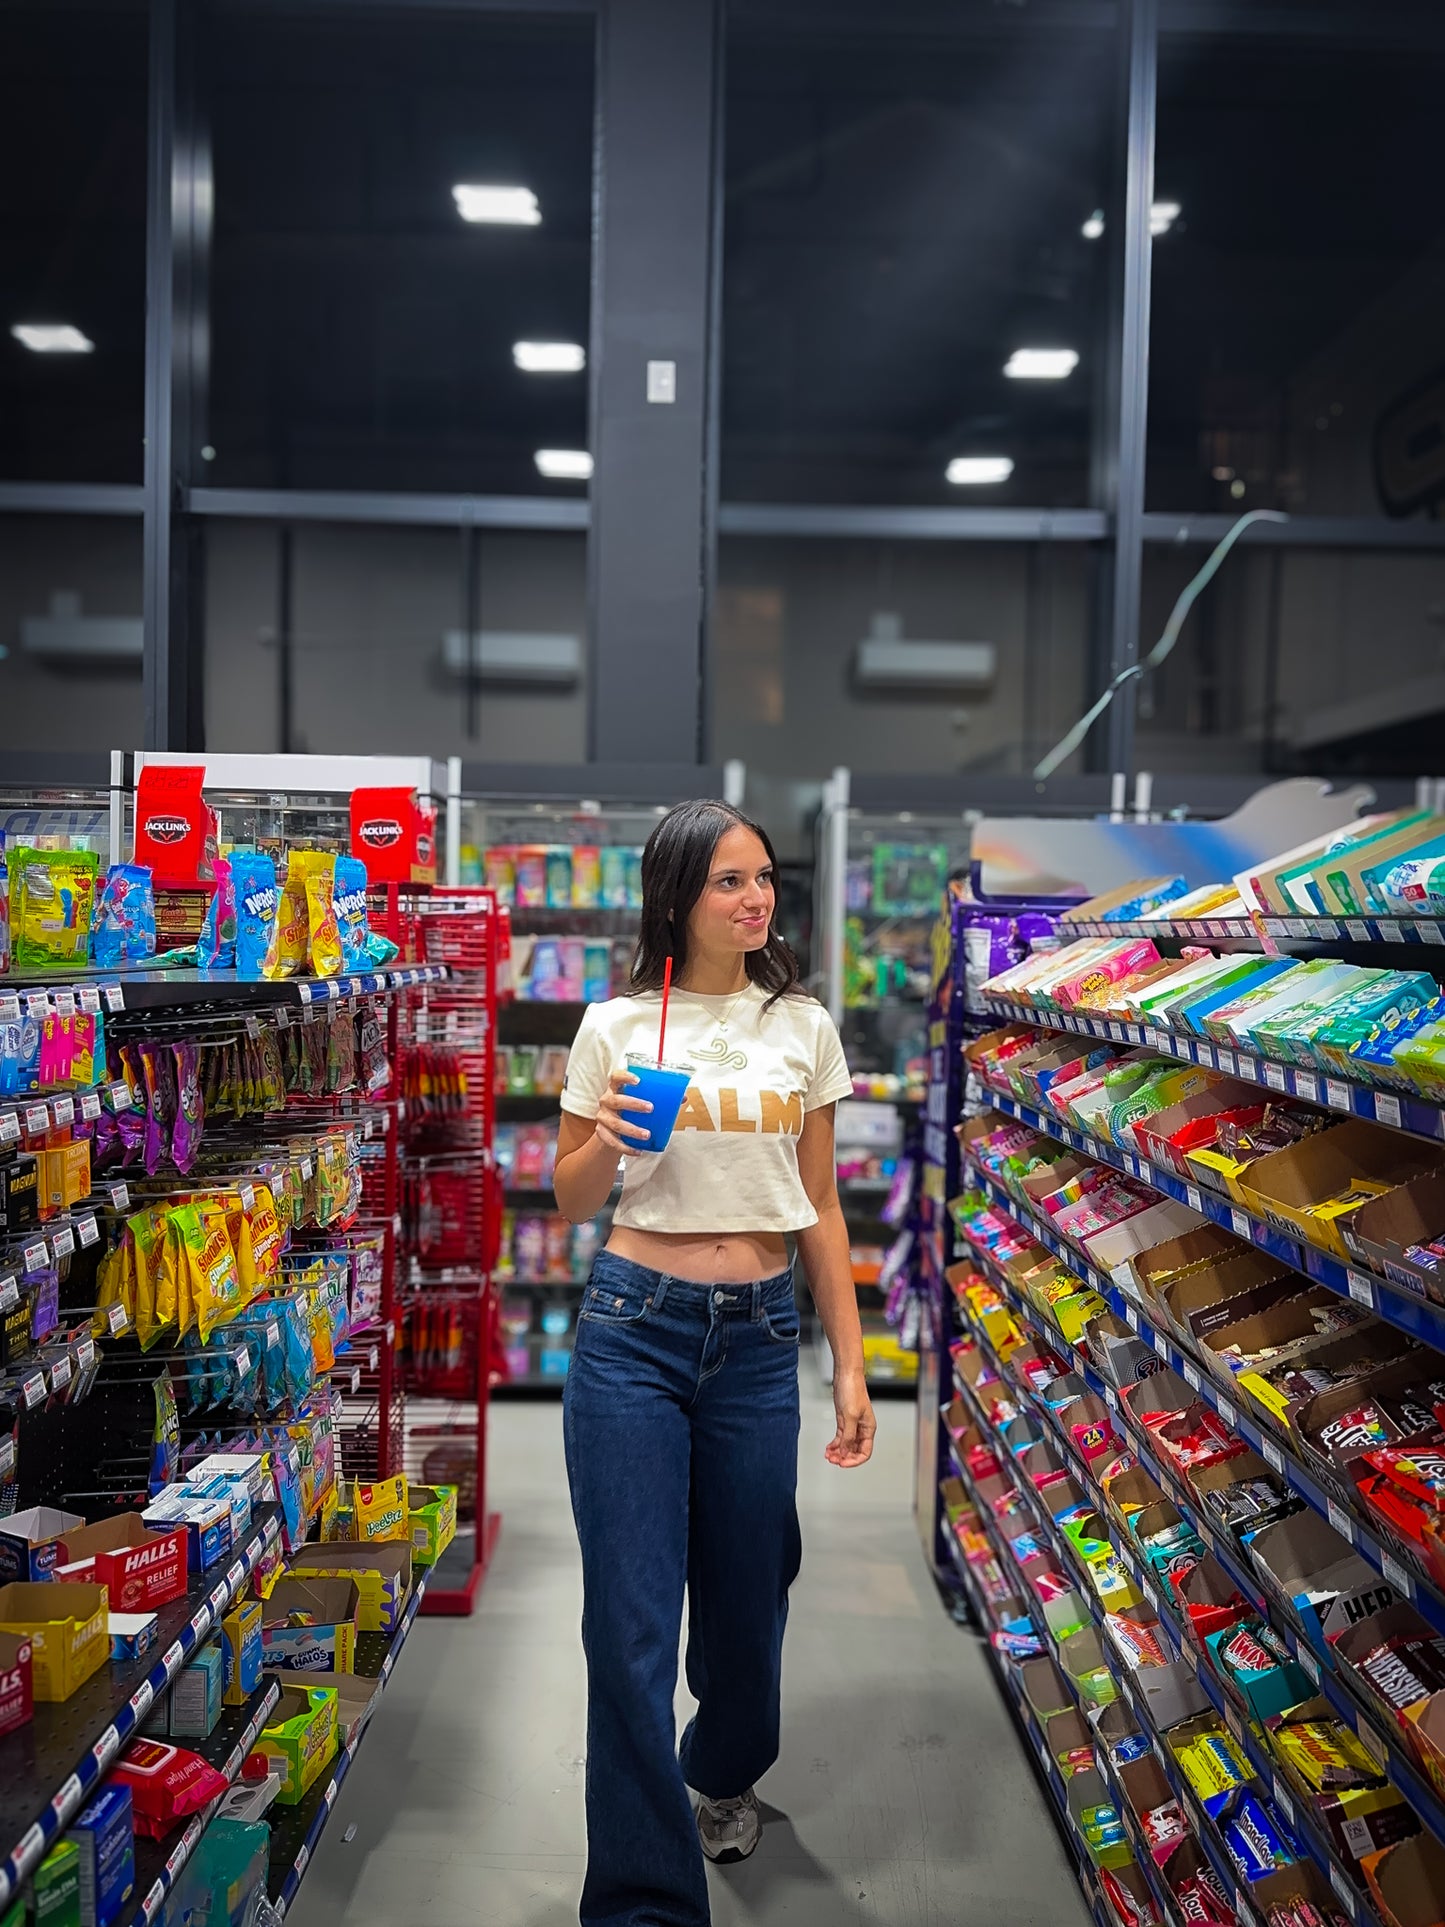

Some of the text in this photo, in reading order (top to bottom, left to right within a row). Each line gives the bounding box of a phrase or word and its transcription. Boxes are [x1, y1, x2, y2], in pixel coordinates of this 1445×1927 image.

[1404, 886, 1417, 898] 50
[674, 1086, 804, 1135] ALM
[1126, 1108, 1145, 1123] tic
[9, 1330, 28, 1346] THIN
[1084, 1428, 1102, 1443] 24
[146, 1564, 178, 1586] RELIEF
[1320, 1603, 1331, 1620] KING
[296, 1650, 328, 1668] HALOS
[298, 1646, 320, 1658] GUMMY
[1228, 1631, 1272, 1672] TWIX
[1365, 1652, 1431, 1709] HERSHE
[186, 1759, 206, 1778] Hand
